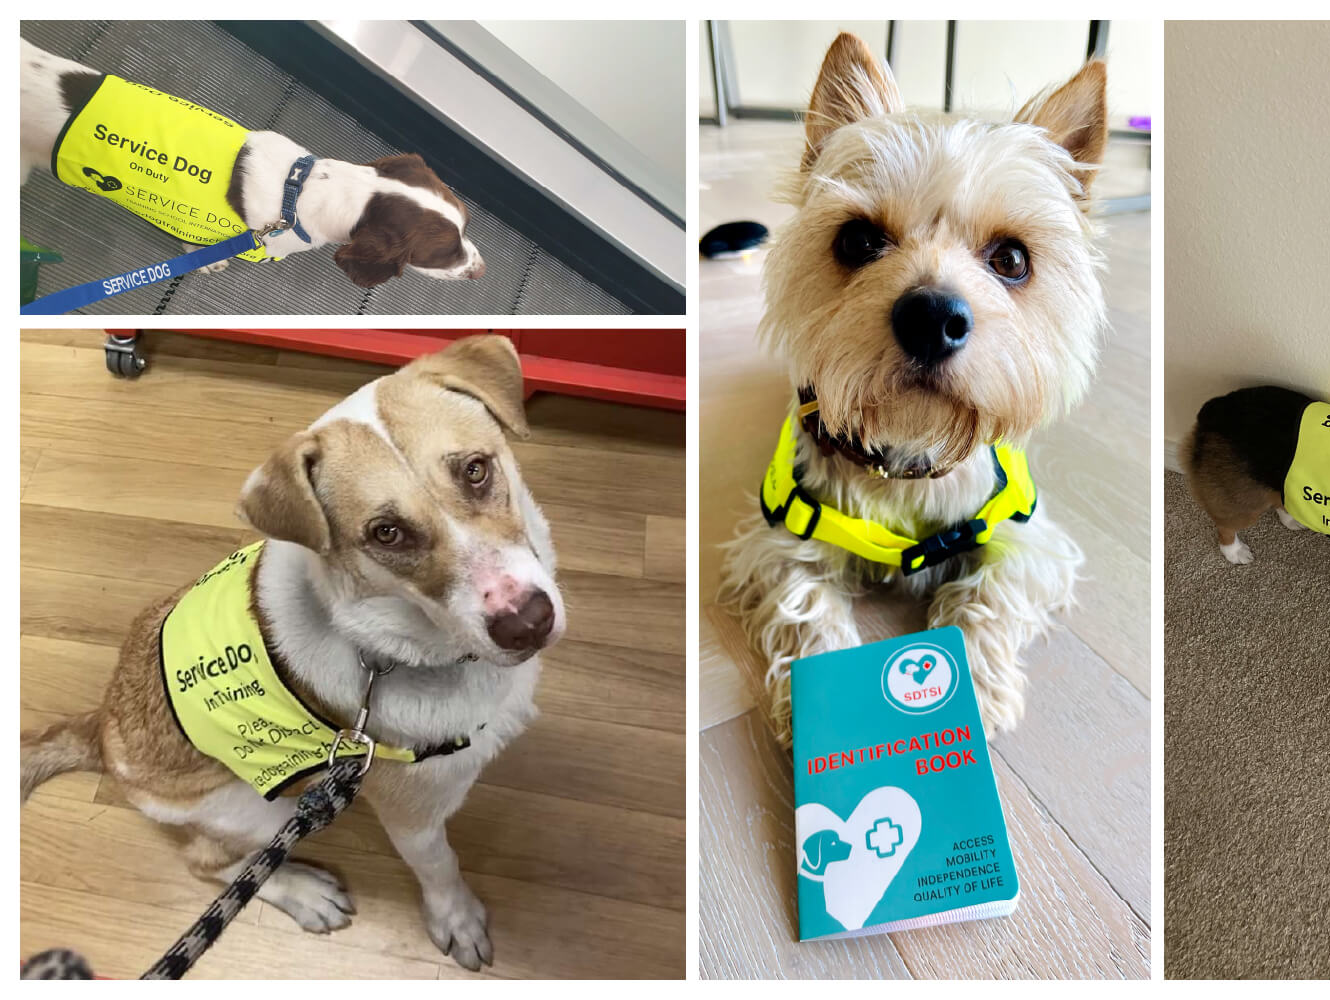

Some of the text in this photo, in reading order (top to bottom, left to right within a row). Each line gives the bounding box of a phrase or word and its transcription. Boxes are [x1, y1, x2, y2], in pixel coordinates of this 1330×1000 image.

[93, 123, 213, 185] Service Dog
[129, 161, 169, 183] On Duty
[125, 185, 243, 234] SERVICE DOG
[102, 263, 171, 296] SERVICE DOG
[225, 643, 258, 671] Do
[903, 686, 942, 702] SDTSI
[807, 725, 972, 776] IDENTIFICATION
[915, 749, 977, 776] BOOK
[952, 835, 995, 852] ACCESS
[946, 848, 997, 868] MOBILITY
[917, 862, 1001, 887] INDEPENDENCE
[913, 876, 1004, 903] QUALITY OF LIFE
